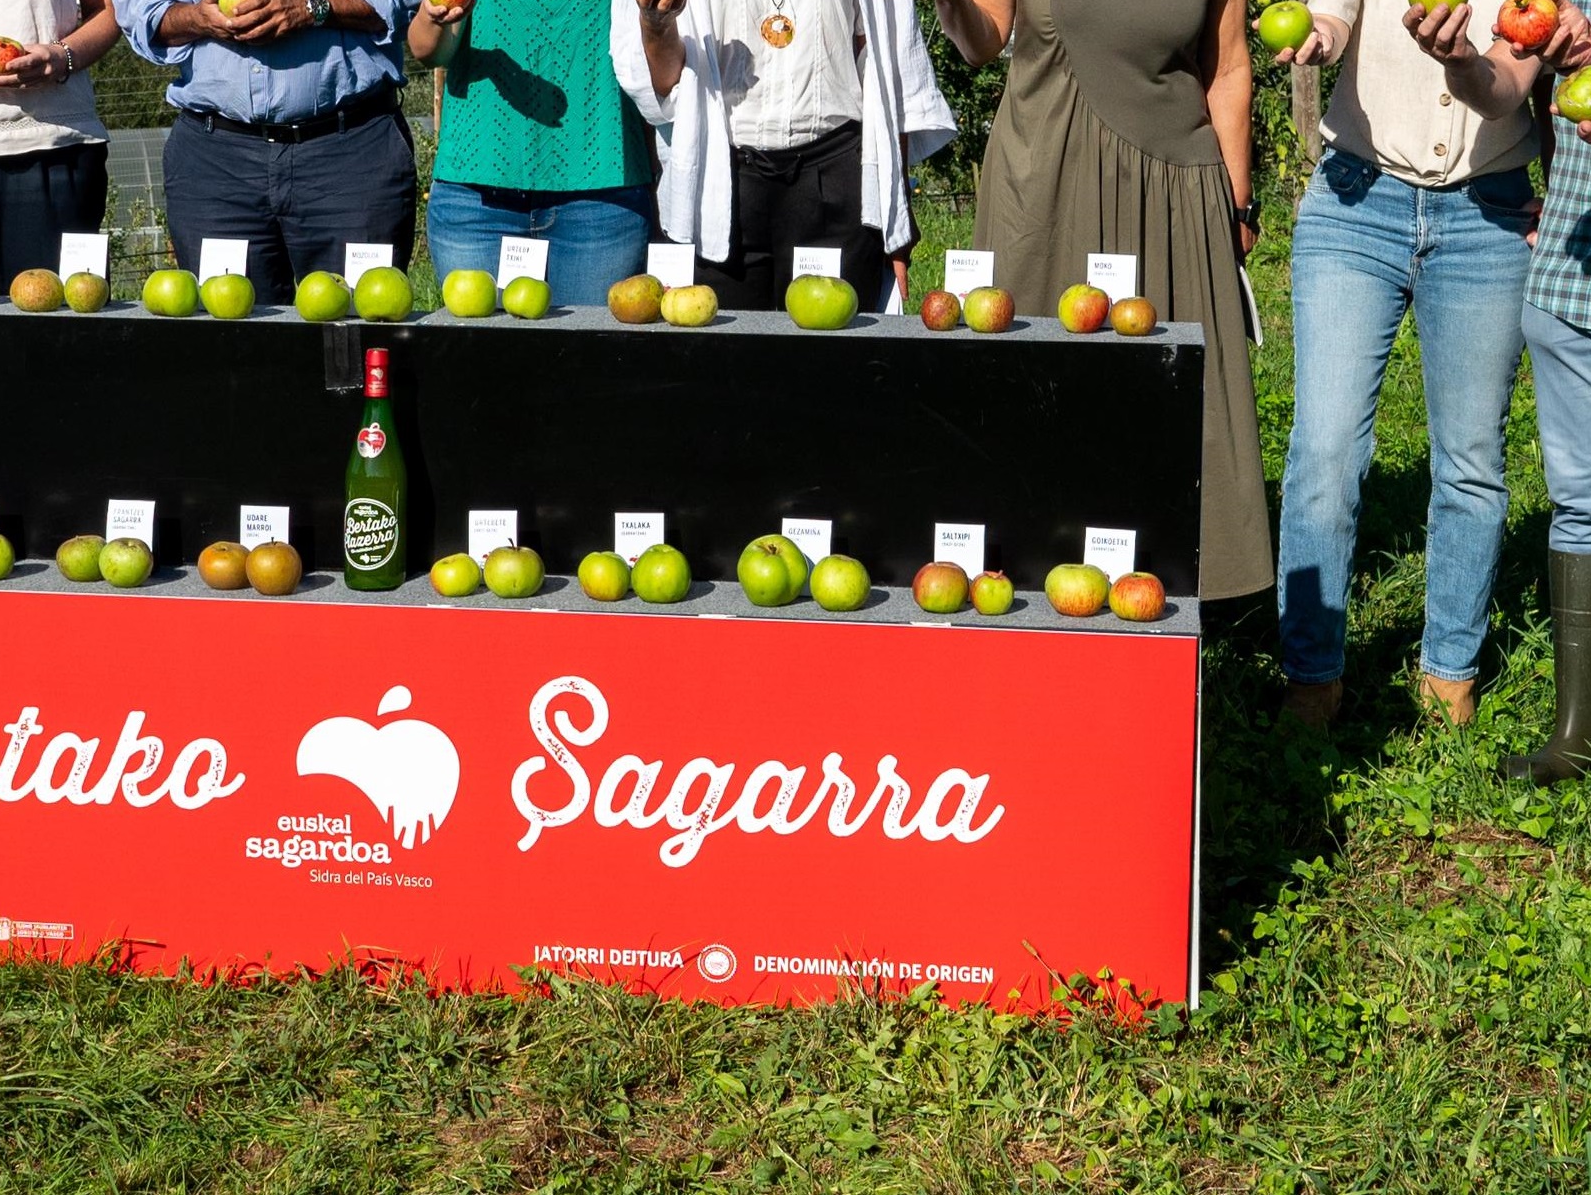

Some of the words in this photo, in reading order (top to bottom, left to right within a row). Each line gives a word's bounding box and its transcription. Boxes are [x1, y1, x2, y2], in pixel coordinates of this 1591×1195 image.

[246, 514, 268, 522] UDARE
[345, 515, 398, 535] Bertako
[622, 521, 651, 529] TXALAKA
[246, 524, 272, 532] MARROI
[942, 532, 971, 541] SALTXIPI
[1091, 536, 1129, 547] GOIKOETXE
[510, 675, 1005, 868] Sagarra
[277, 813, 352, 836] euskal
[245, 834, 392, 868] sagardoa
[310, 869, 341, 884] Sidra
[344, 870, 364, 885] del
[367, 871, 393, 887] País
[395, 873, 433, 888] Vasco
[534, 945, 604, 966] JATORRI
[609, 948, 684, 968] DEITURA
[899, 963, 922, 980] DE
[925, 964, 993, 984] ORIGEN
